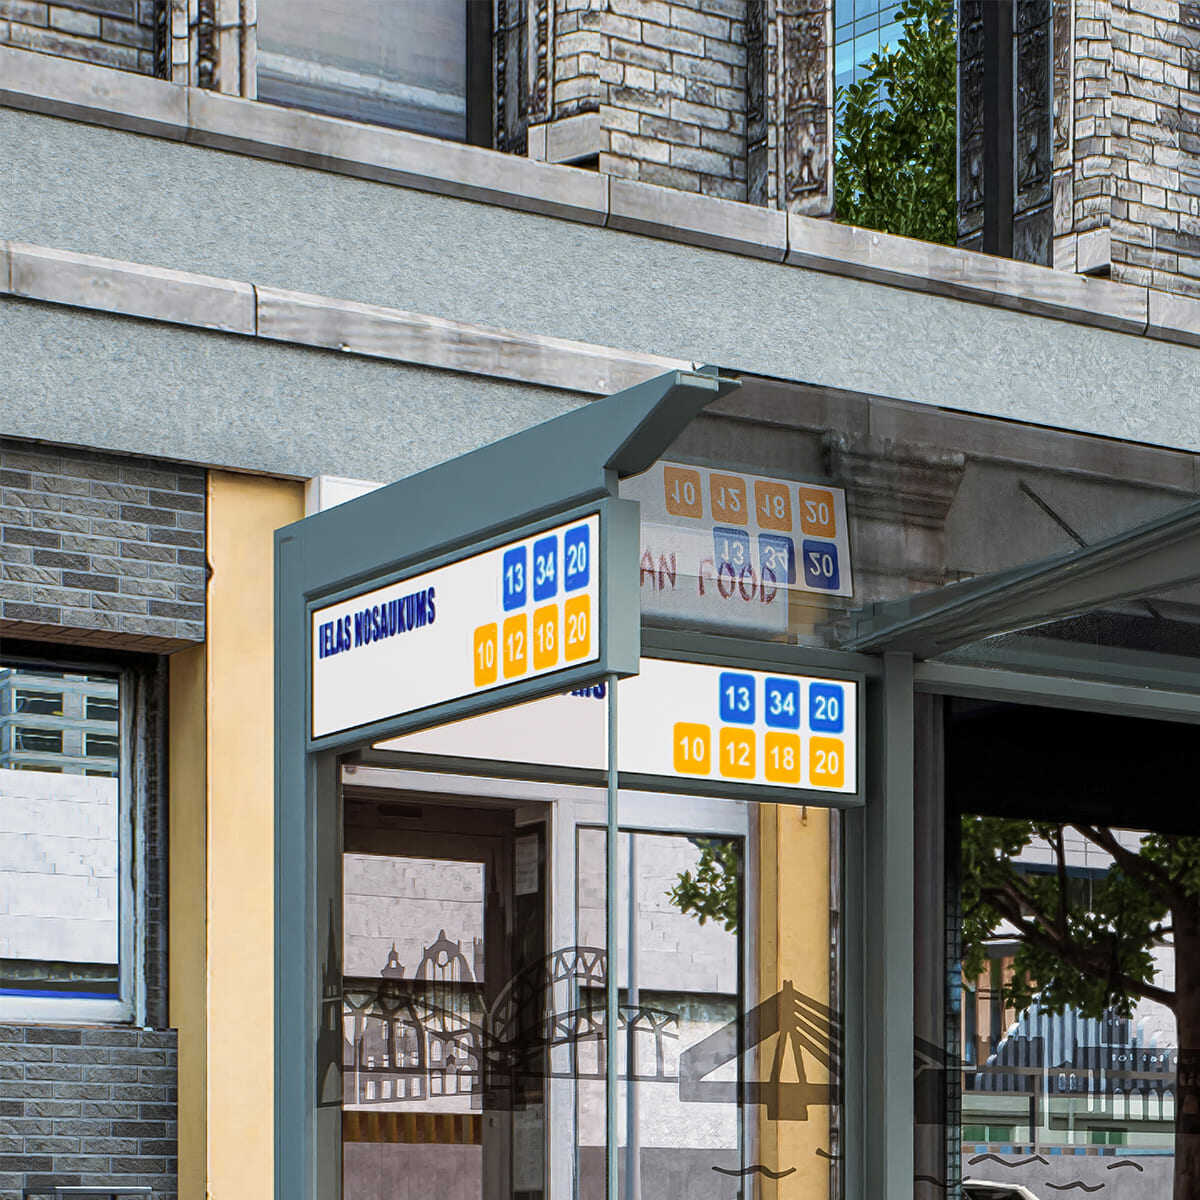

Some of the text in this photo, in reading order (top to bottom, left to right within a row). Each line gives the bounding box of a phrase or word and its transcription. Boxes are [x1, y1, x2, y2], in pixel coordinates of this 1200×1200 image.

[506, 541, 586, 596] 13 34 20
[697, 558, 778, 606] FOOD
[319, 586, 436, 660] IELAS NOSAUKUMS
[478, 611, 586, 671] 10 12 18 20
[725, 685, 840, 722] 13 34 20
[679, 735, 840, 775] 10 12 18 20
